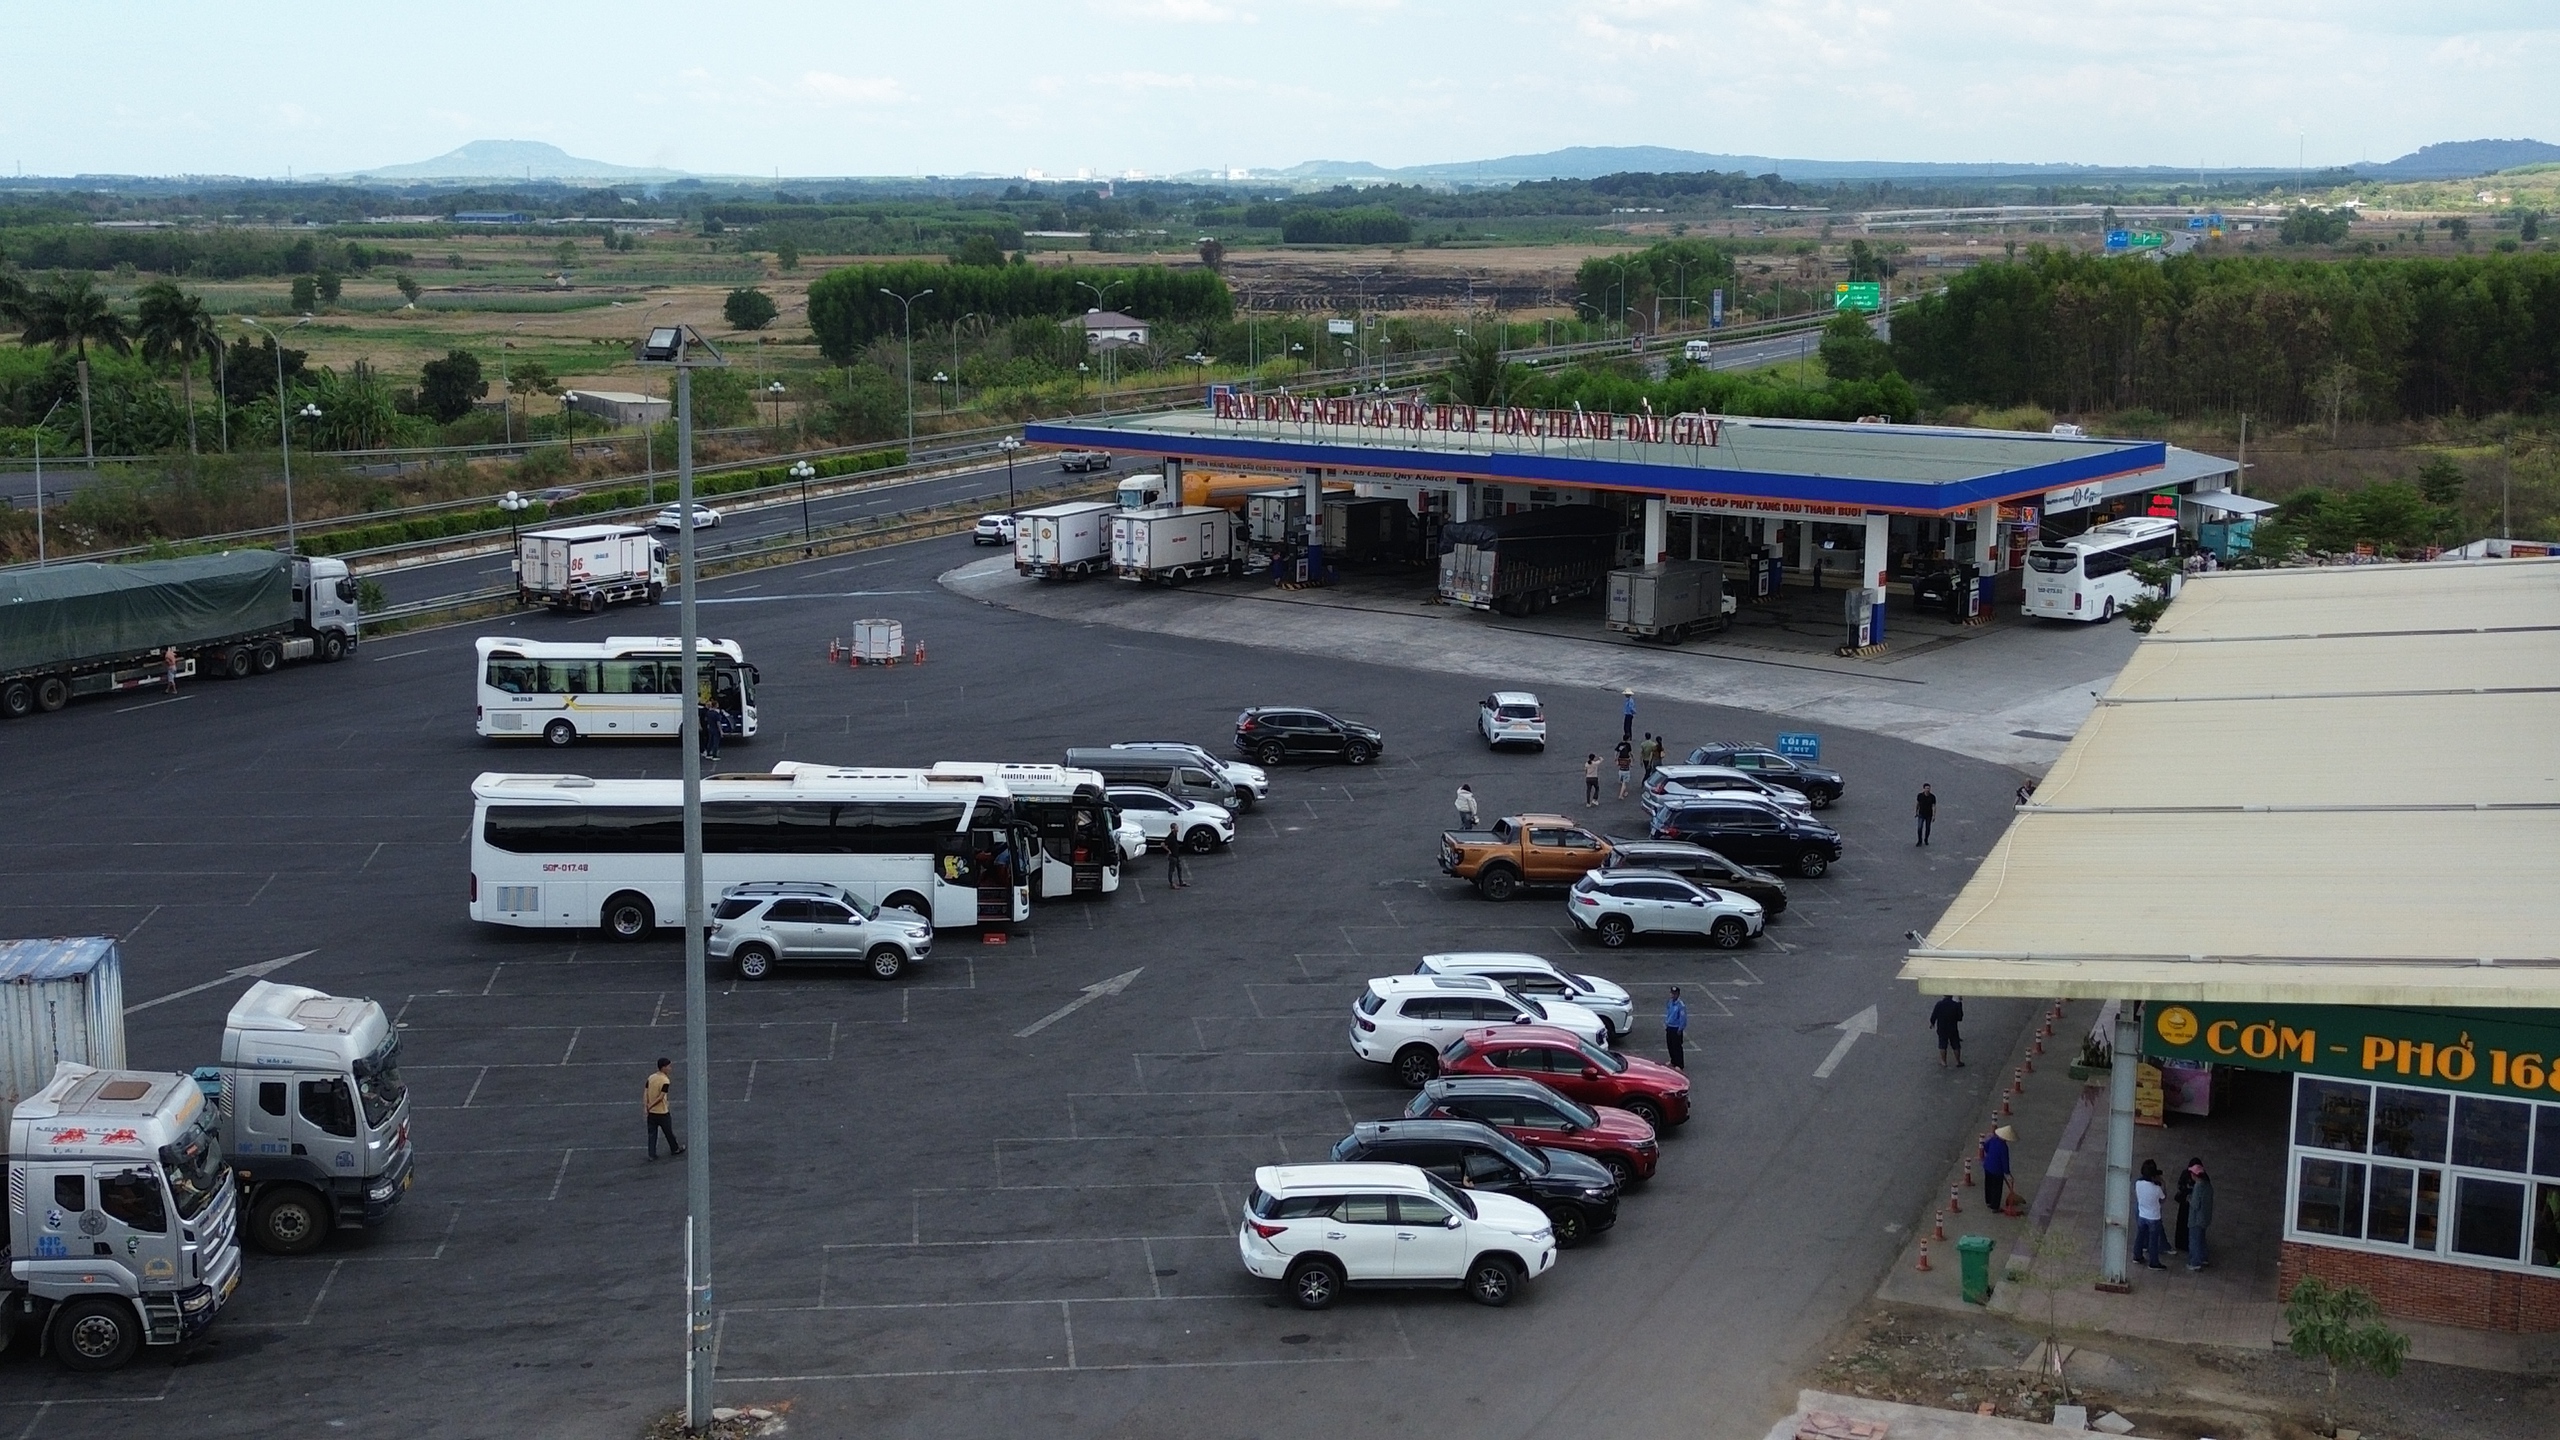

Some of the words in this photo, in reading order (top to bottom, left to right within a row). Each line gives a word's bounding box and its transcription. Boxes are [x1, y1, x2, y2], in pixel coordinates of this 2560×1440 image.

[1359, 399, 1394, 429] CAO
[1436, 404, 1479, 434] HCM
[1492, 406, 1543, 438] LONG
[571, 557, 584, 571] 86
[1802, 738, 1816, 746] RA
[2206, 1019, 2317, 1064] CƠM
[2362, 1031, 2476, 1081] PHỞ
